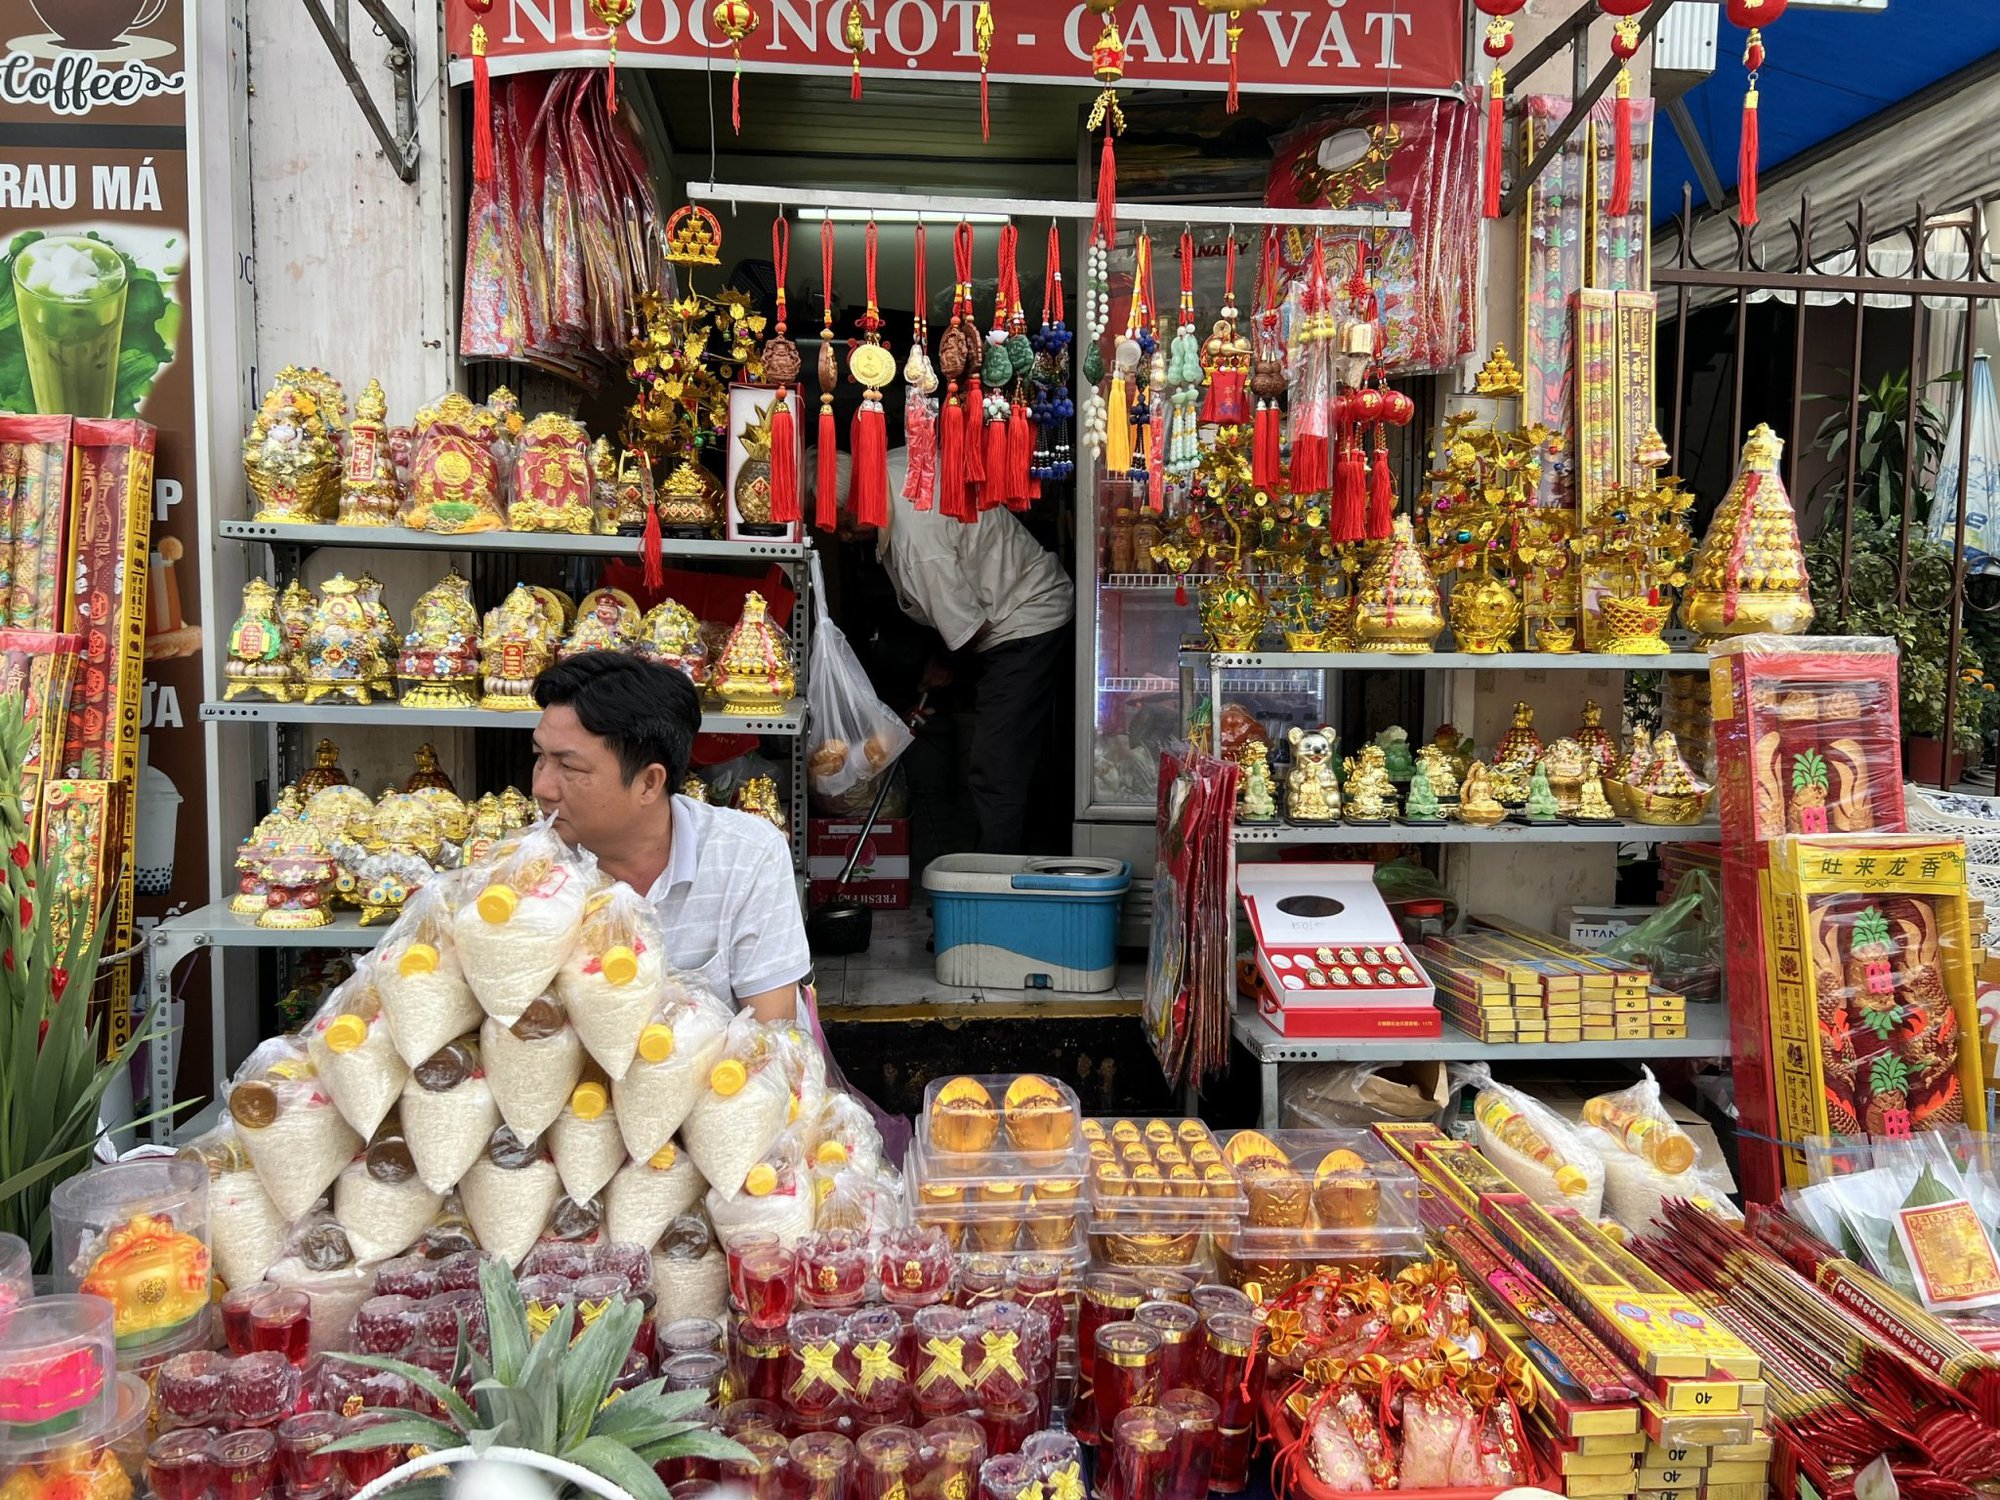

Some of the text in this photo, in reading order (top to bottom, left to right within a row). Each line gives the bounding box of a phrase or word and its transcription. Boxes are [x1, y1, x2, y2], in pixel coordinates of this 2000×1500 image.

[766, 0, 990, 69] NGỌT
[1017, 34, 1036, 45] -
[1063, 3, 1231, 65] CAM
[0, 54, 184, 111] Coffee
[0, 156, 163, 211] RAU MÁ
[149, 478, 183, 522] P
[860, 893, 897, 904] FRESH
[1576, 928, 1617, 938] TITAN
[1695, 1392, 1712, 1403] 40
[1668, 1449, 1686, 1460] 40
[1662, 1471, 1681, 1482] 40
